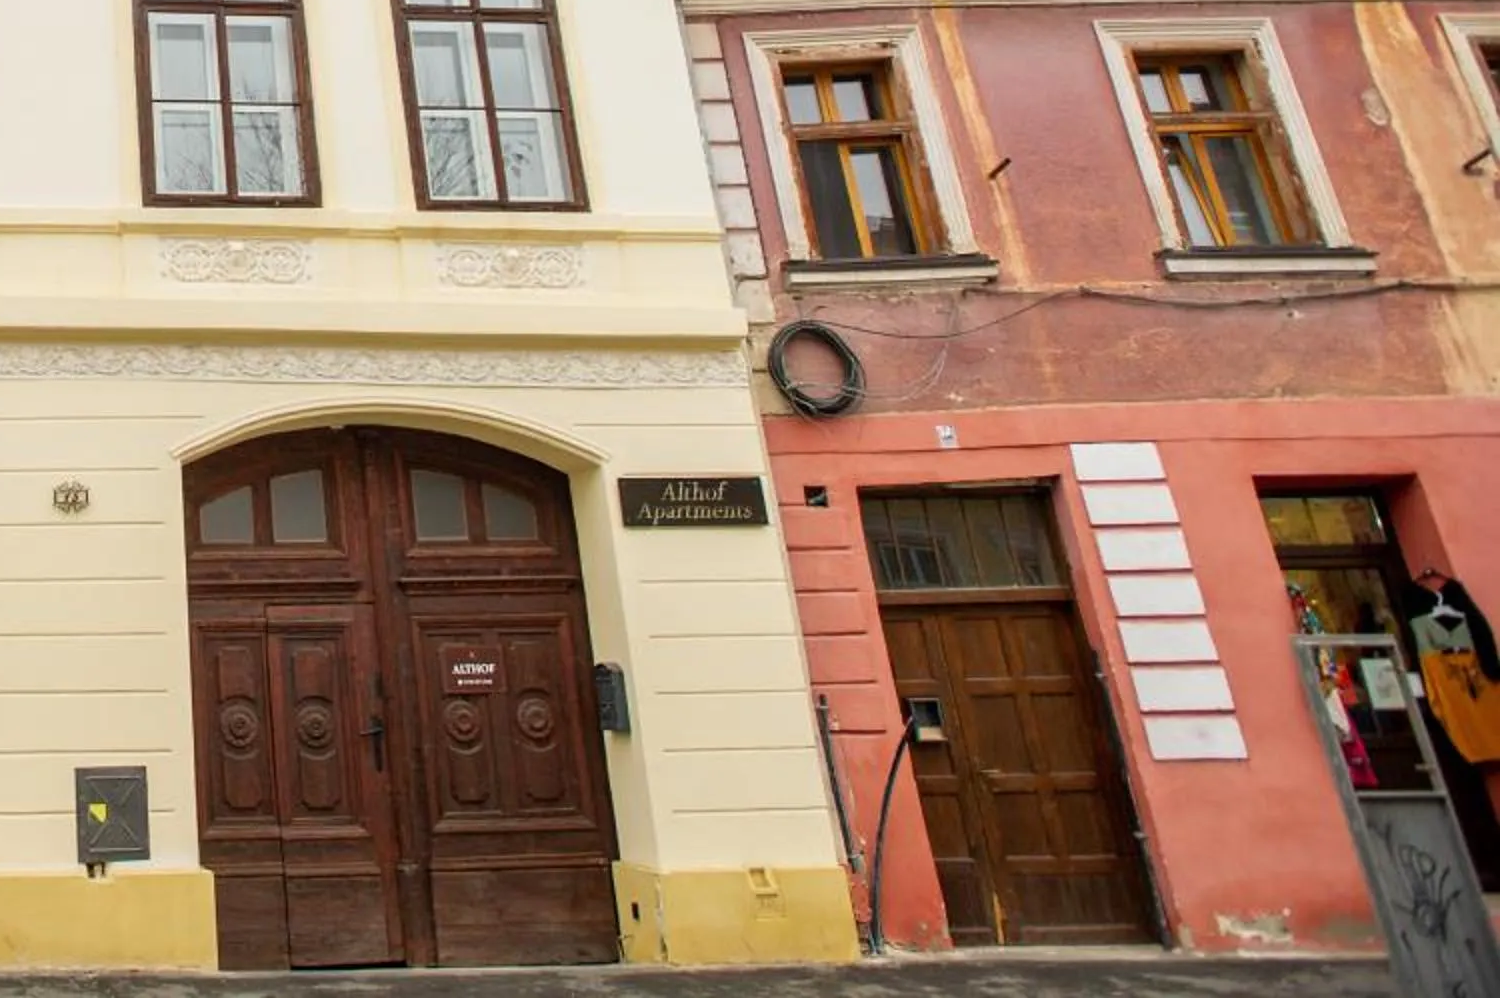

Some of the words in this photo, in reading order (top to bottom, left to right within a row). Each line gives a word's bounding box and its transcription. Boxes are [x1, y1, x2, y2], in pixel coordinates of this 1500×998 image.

[660, 480, 728, 501] Althof
[638, 502, 753, 525] Apartments
[452, 662, 496, 674] ALTHOF
